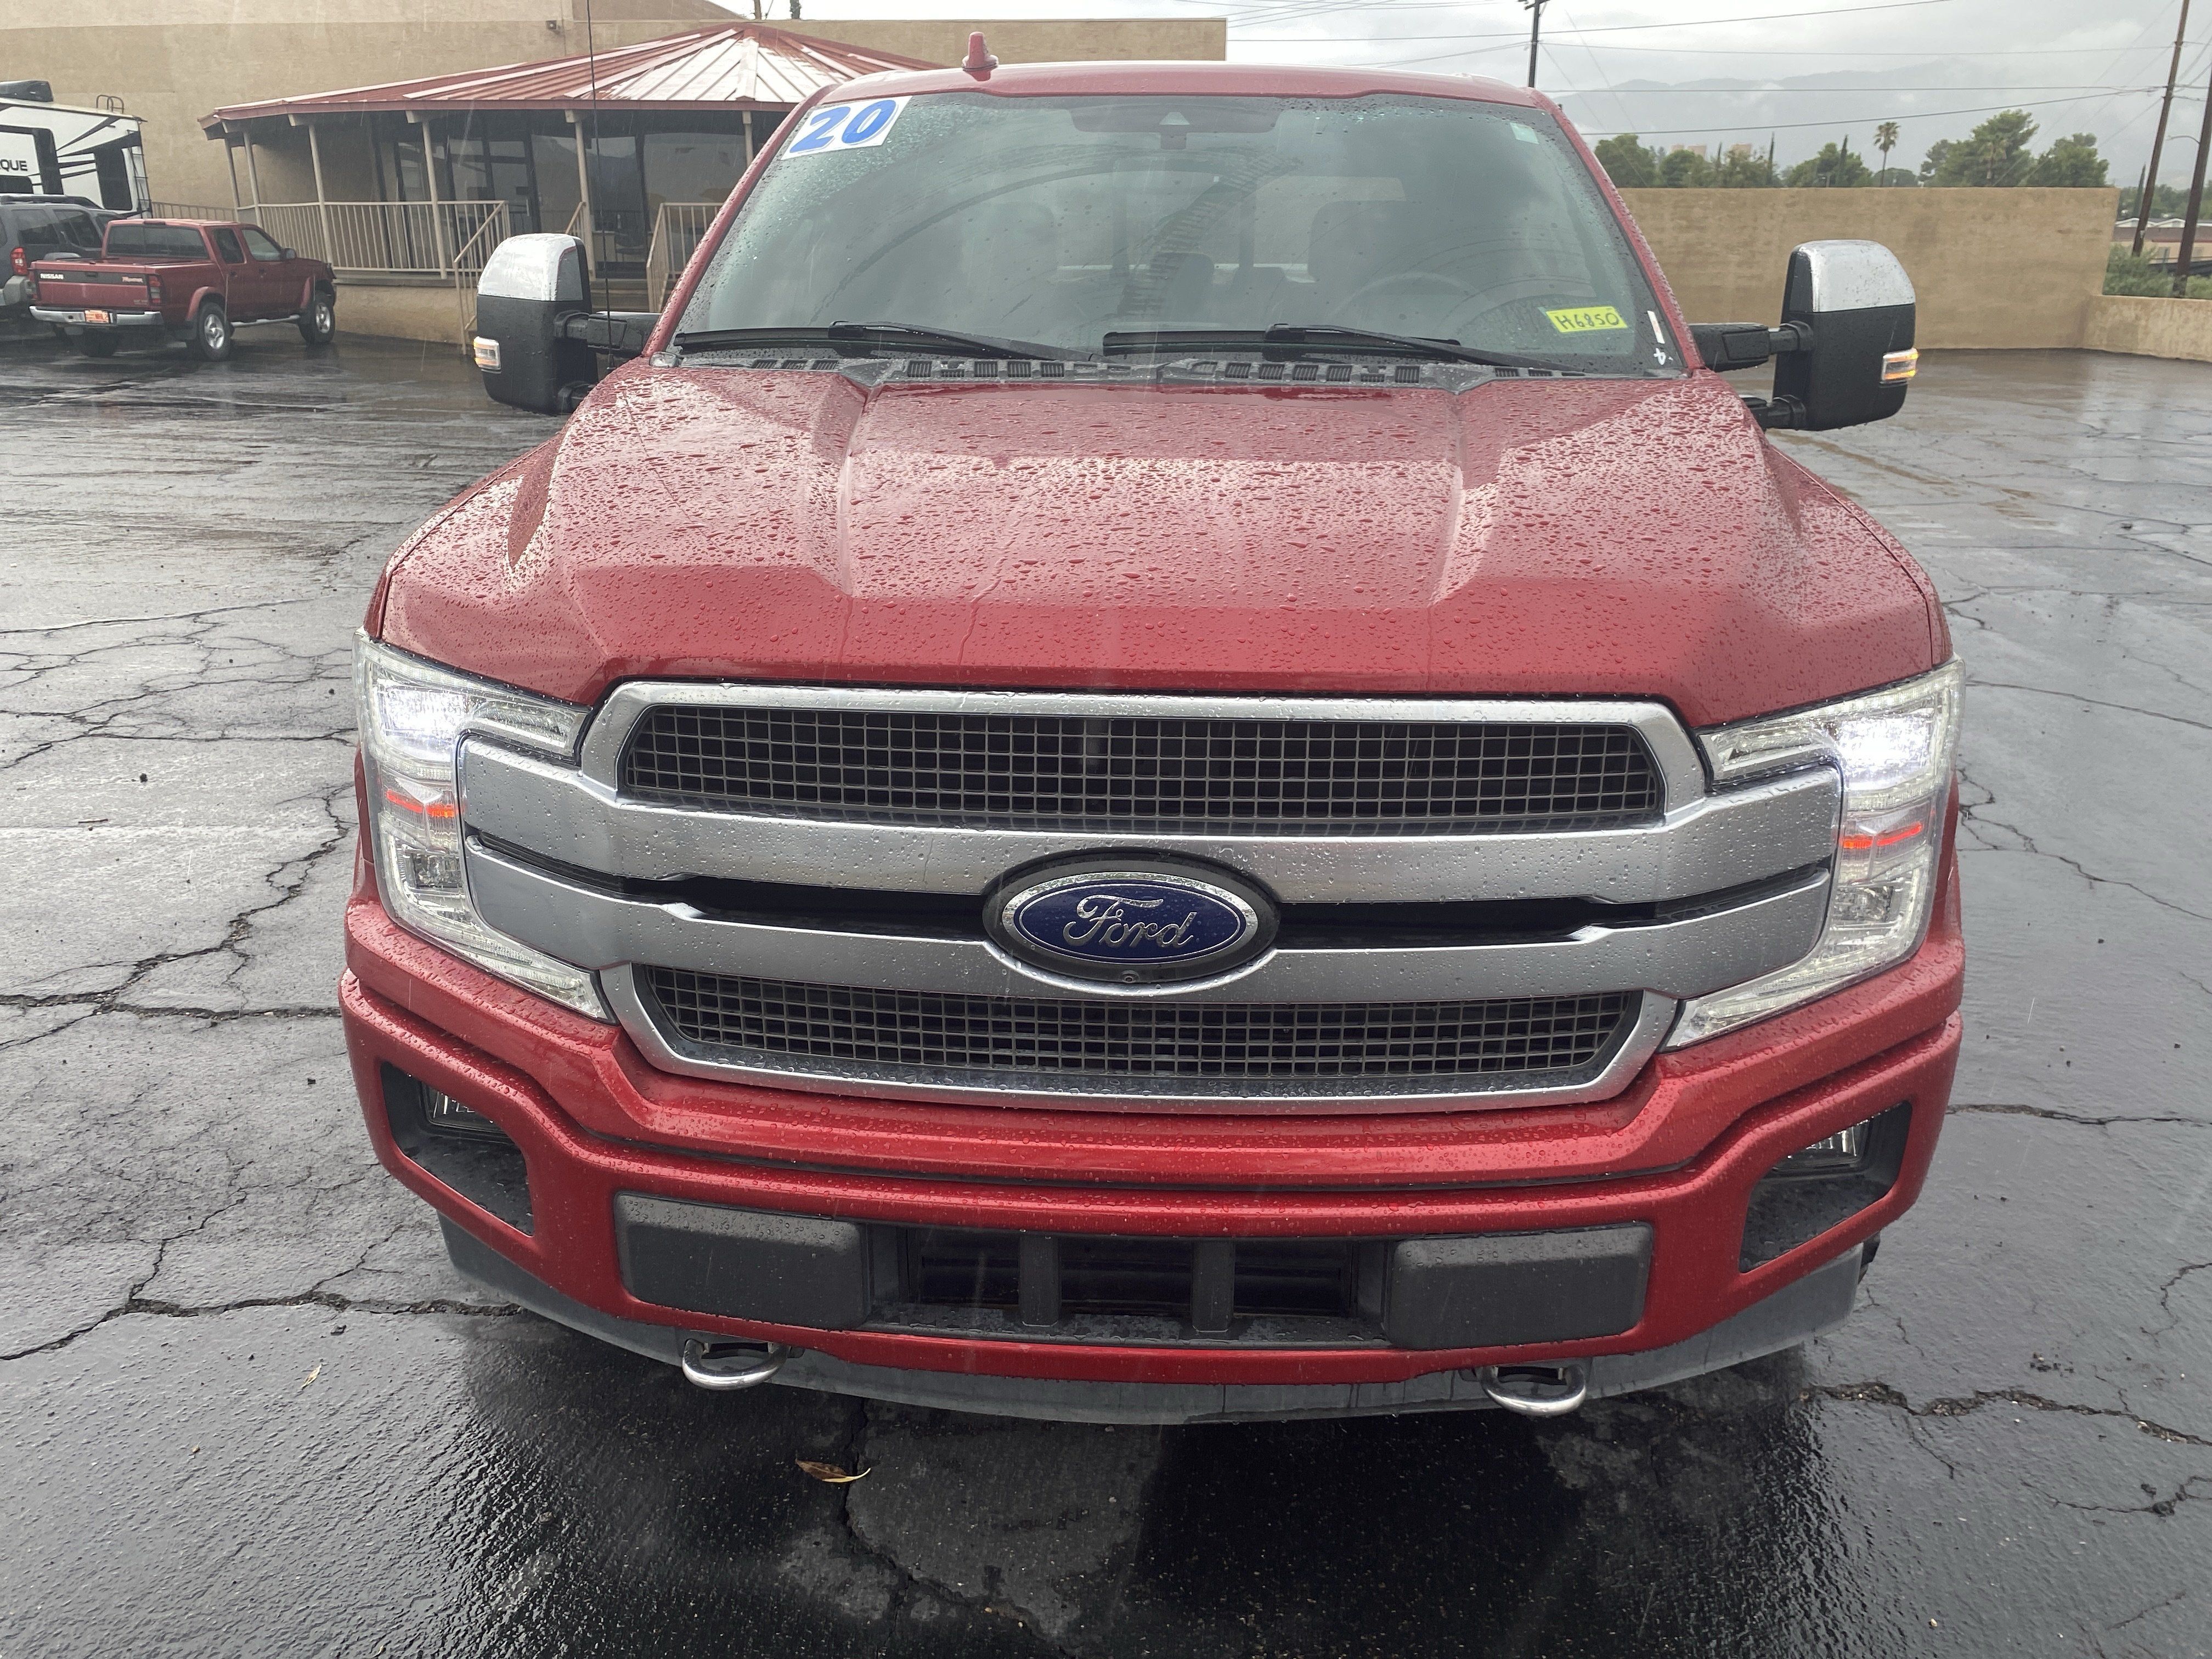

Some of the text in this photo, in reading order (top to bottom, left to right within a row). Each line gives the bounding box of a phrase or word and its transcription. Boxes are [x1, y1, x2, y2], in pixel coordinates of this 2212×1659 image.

[789, 99, 899, 154] 20
[1554, 313, 1620, 330] H6850
[1063, 894, 1197, 947] Ford
